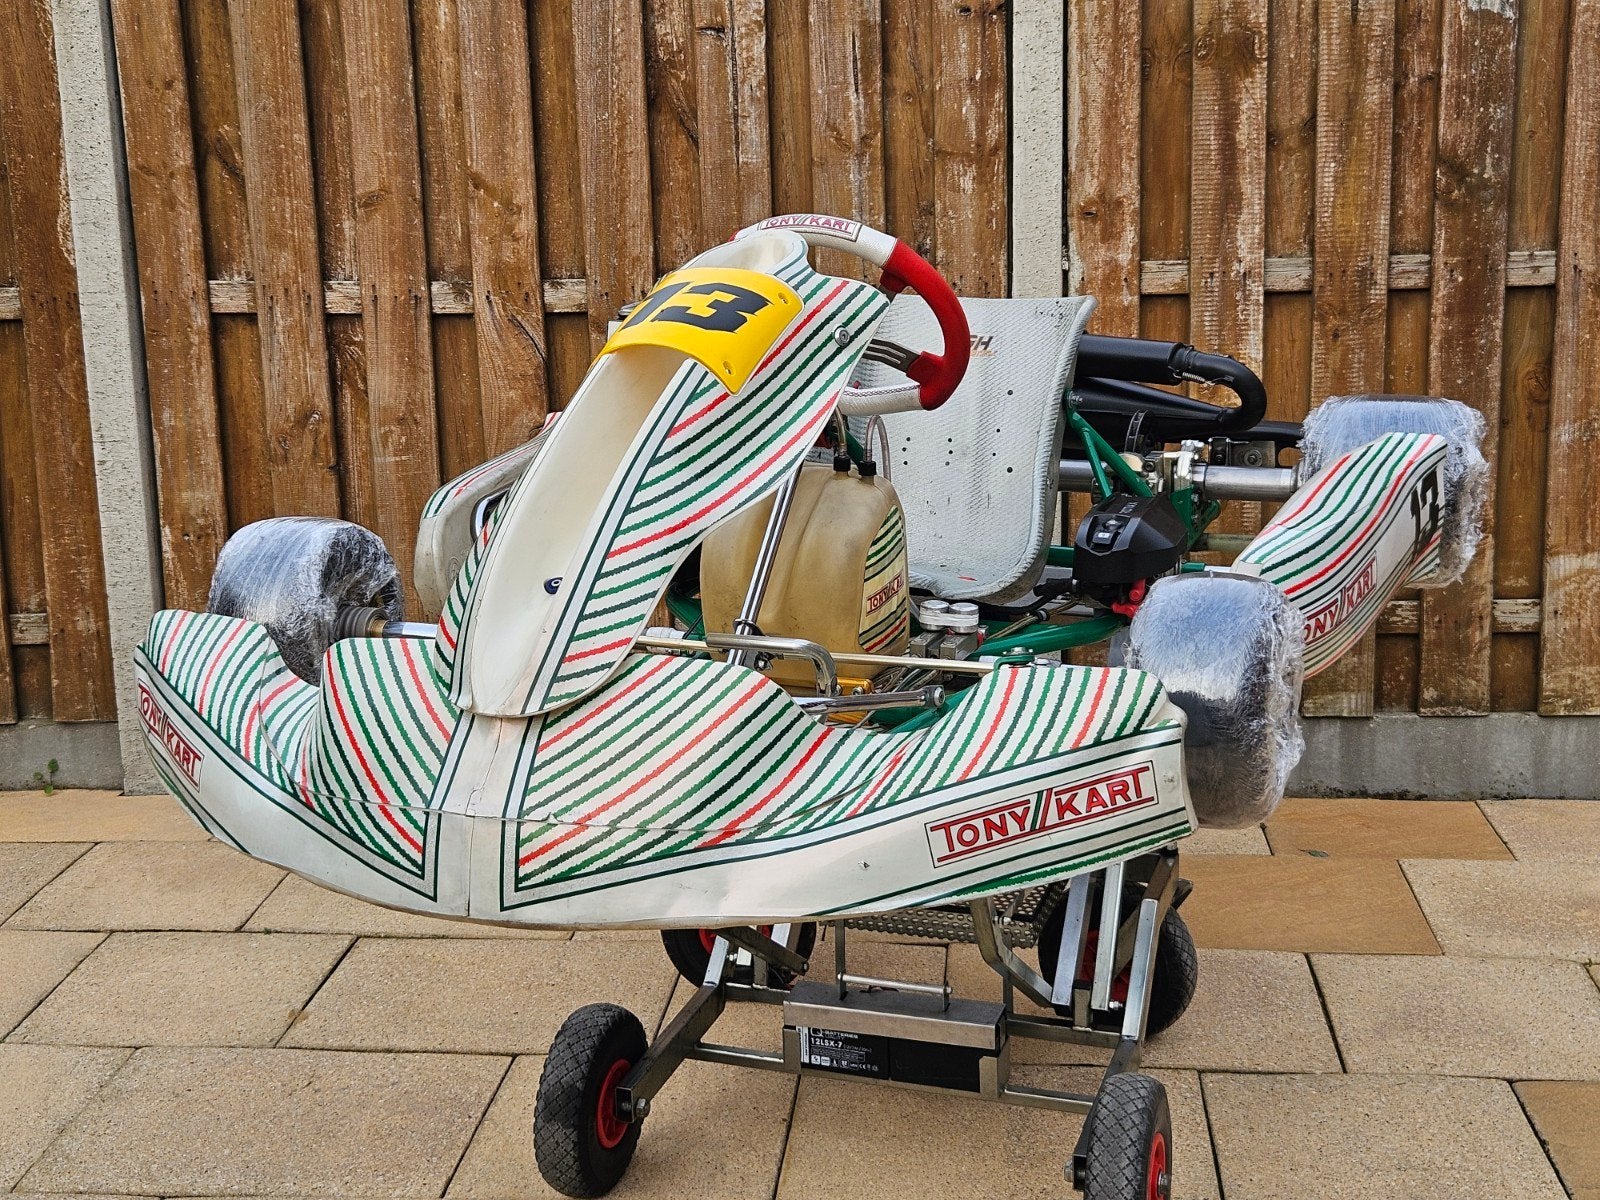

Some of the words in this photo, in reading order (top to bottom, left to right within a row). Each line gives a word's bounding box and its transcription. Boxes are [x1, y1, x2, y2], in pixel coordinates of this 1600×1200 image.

[618, 281, 775, 334] 13
[1346, 556, 1376, 614] KART
[166, 721, 202, 777] KART
[930, 799, 1031, 852] TONY
[1054, 765, 1150, 820] KART
[811, 1037, 843, 1048] 12LSX-7
